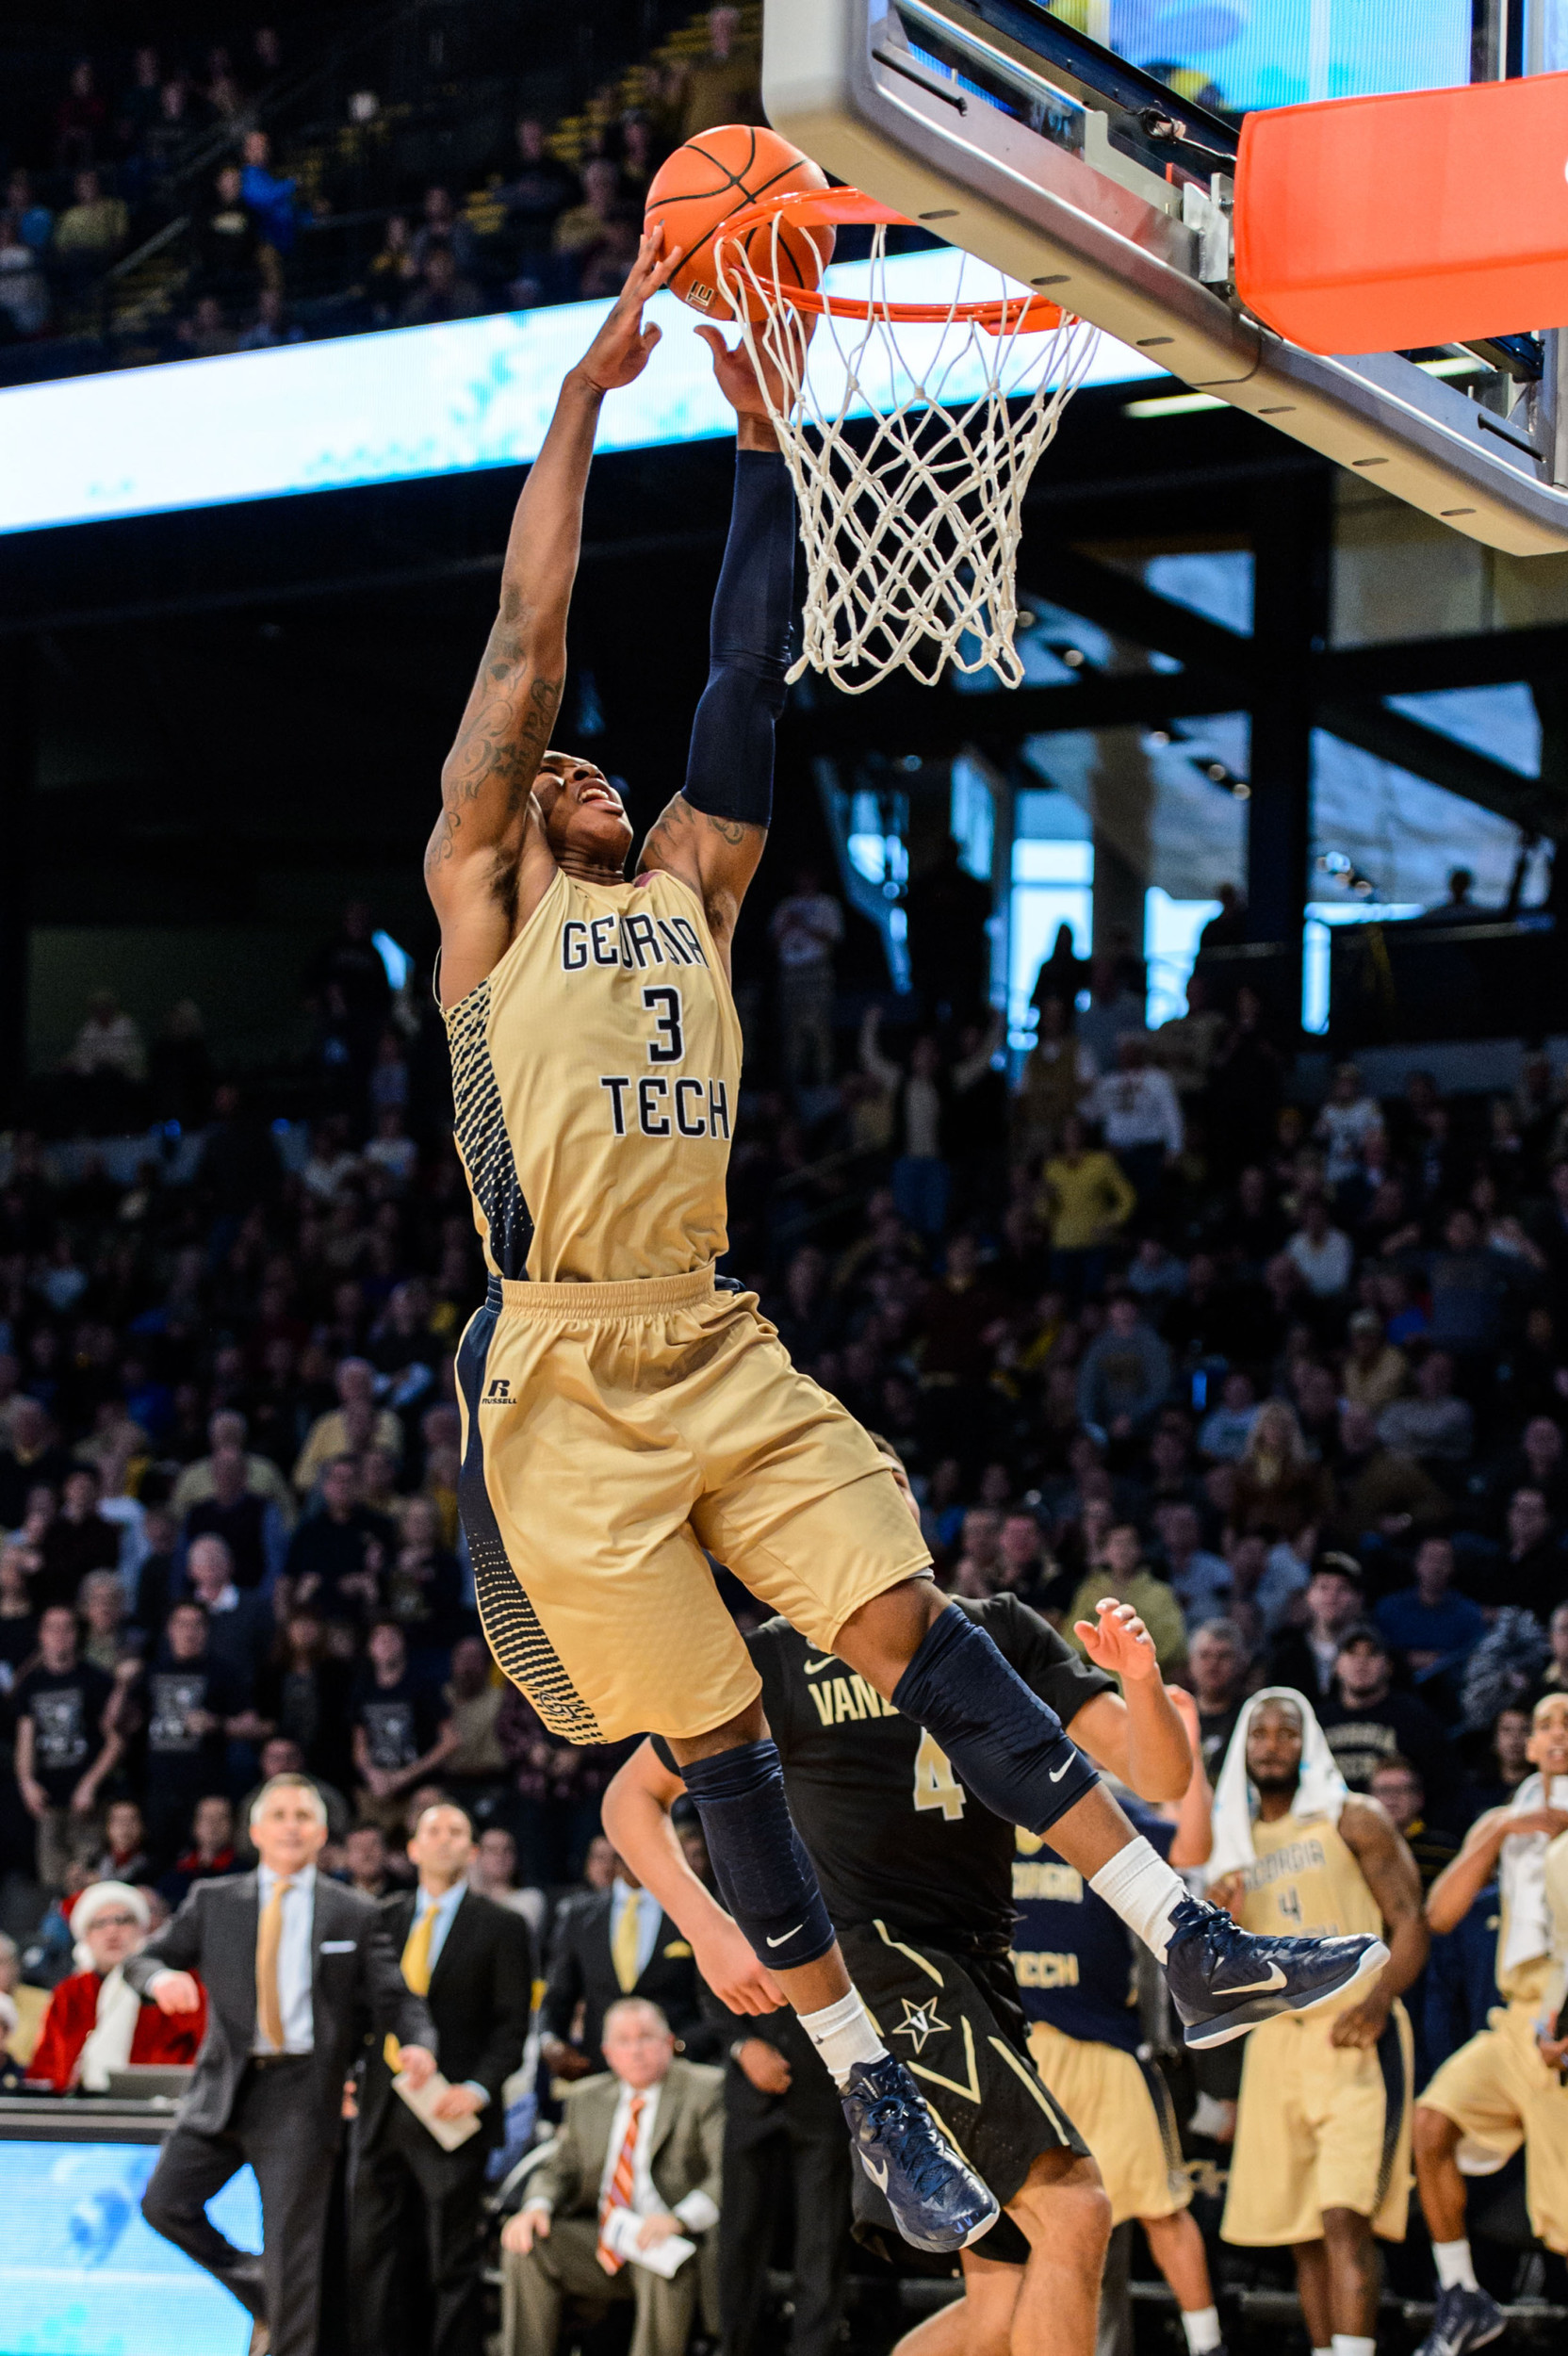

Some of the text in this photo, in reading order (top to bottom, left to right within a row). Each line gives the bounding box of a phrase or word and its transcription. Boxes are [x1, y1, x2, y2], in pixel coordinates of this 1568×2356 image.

[641, 984, 686, 1066] 3
[598, 1074, 731, 1141] TECH
[912, 1726, 967, 1822] 4
[1278, 1885, 1302, 1924] 4
